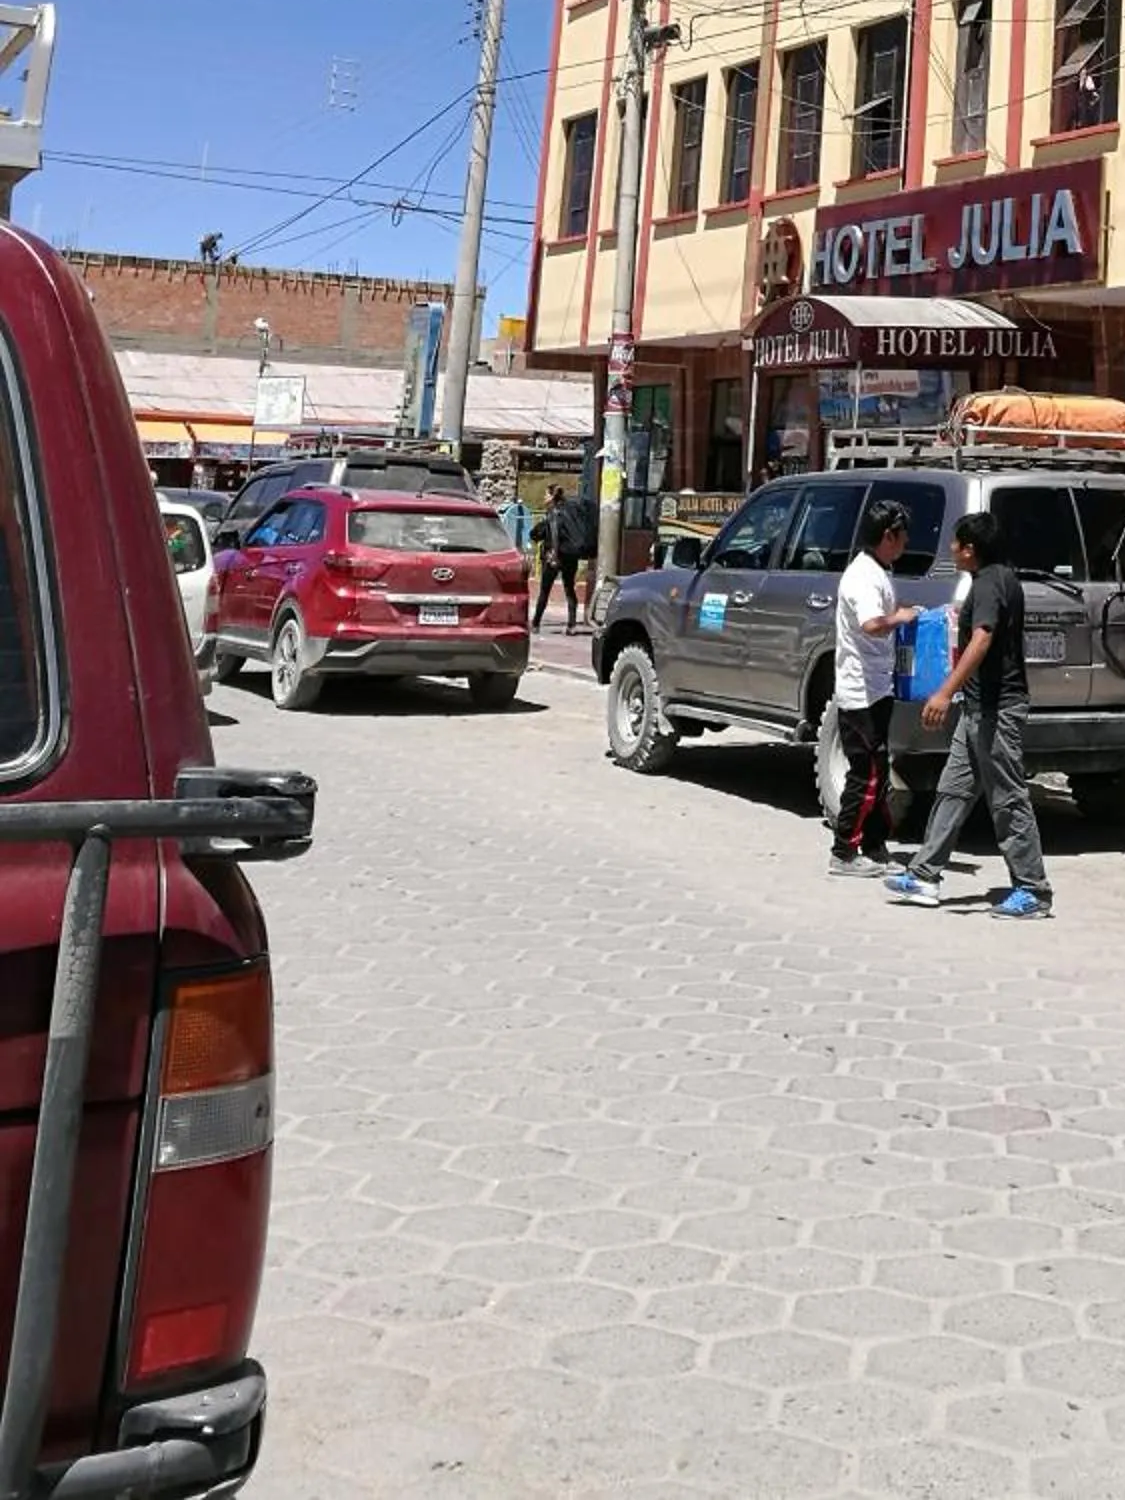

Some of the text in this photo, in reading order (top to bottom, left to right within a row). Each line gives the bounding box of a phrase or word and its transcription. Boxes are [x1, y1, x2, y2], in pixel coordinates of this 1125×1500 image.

[811, 189, 1083, 286] HOTEL JULIA
[753, 327, 850, 367] HOTEL JULIA
[877, 328, 1057, 359] HOTEL JULIA
